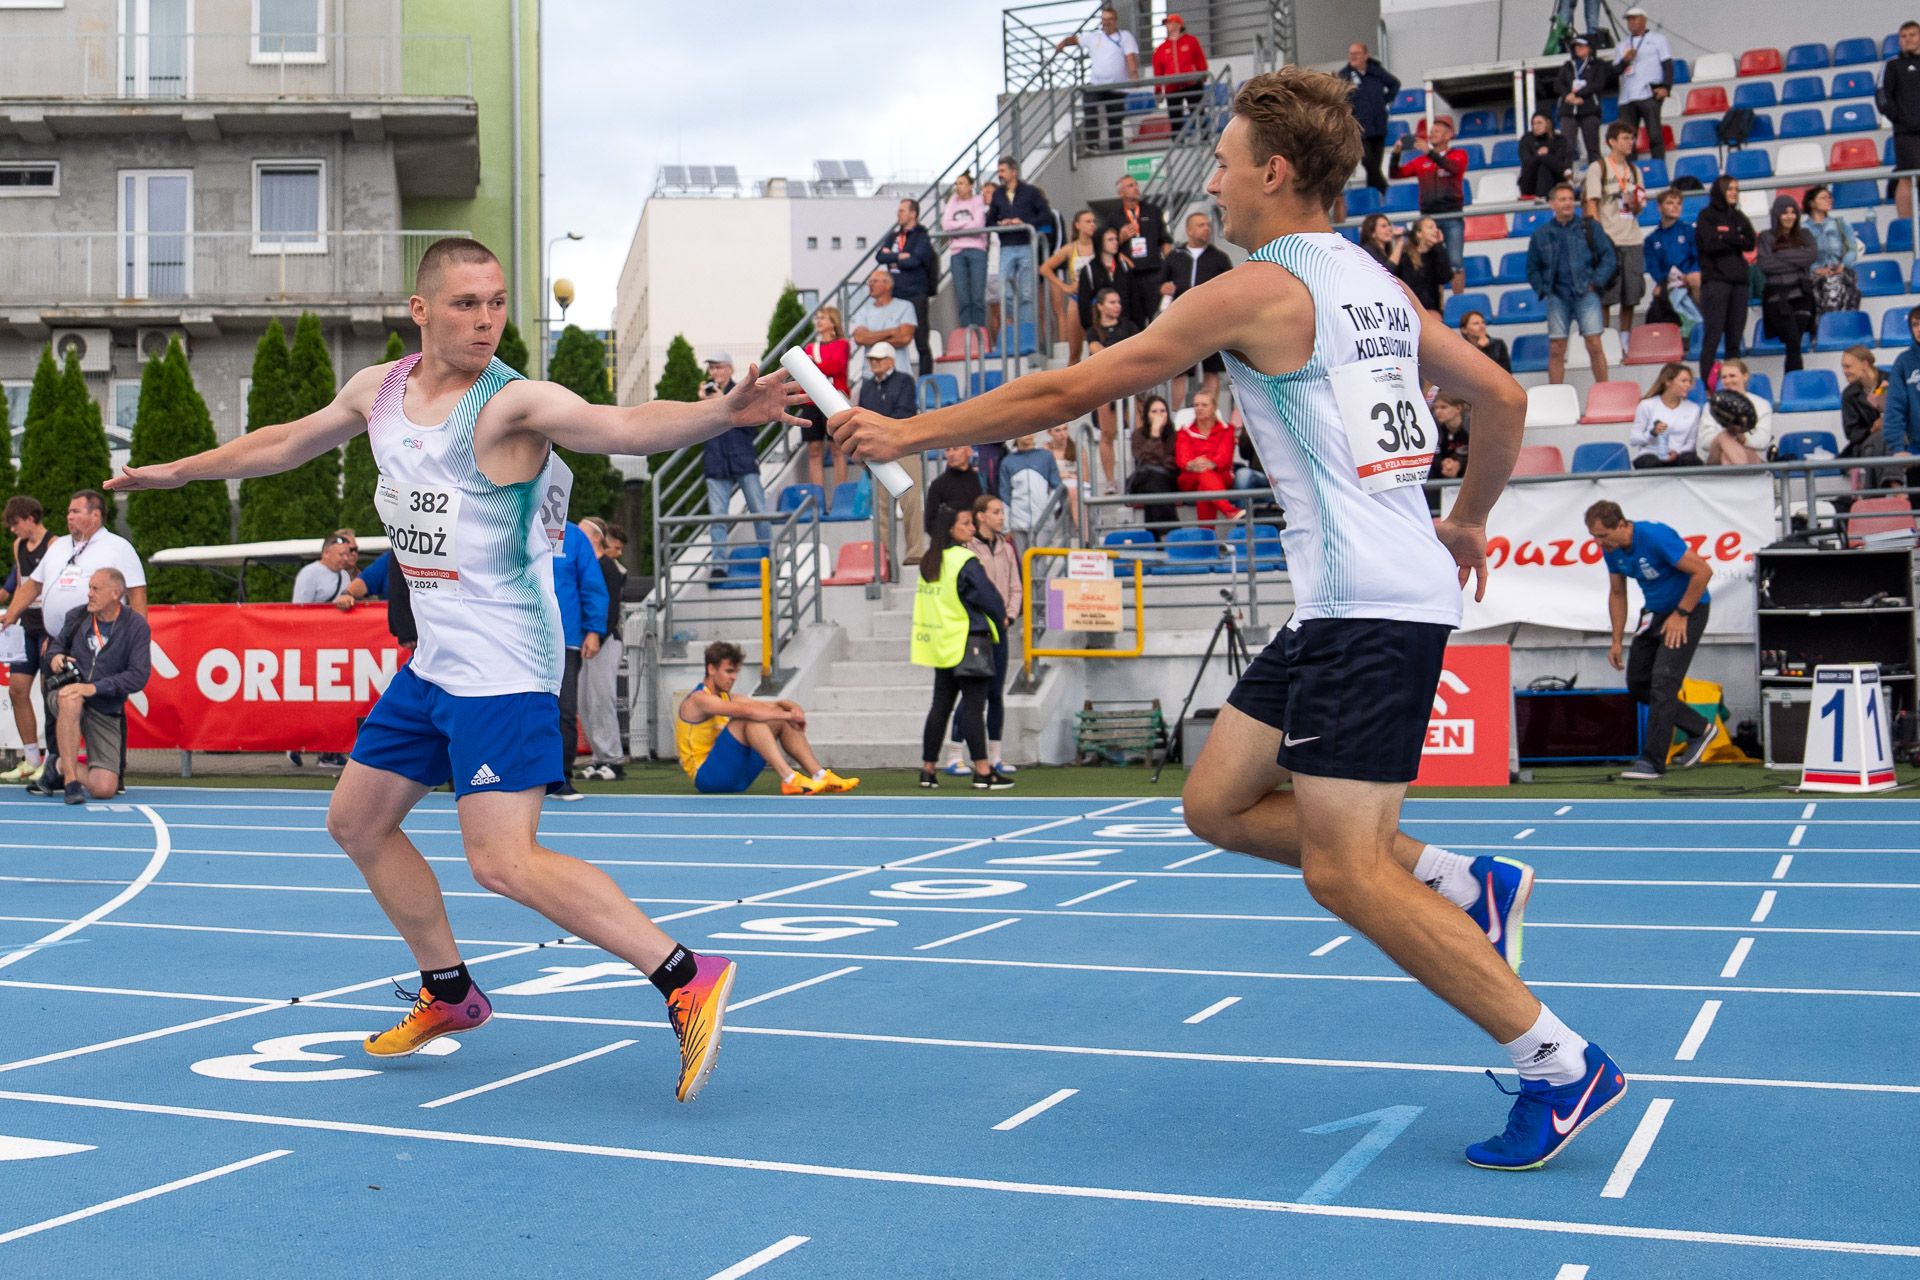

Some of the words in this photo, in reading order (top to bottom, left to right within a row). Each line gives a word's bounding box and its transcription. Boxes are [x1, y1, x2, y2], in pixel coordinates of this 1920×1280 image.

[1341, 302, 1411, 332] TIKI-TAKA
[1371, 400, 1426, 453] 383
[410, 491, 449, 514] 382
[414, 580, 438, 589] 2024
[196, 648, 398, 702] ORLEN
[1424, 726, 1465, 748] EN
[1821, 688, 1845, 762] 1
[1866, 688, 1884, 762] 1
[470, 775, 501, 786] adidas
[664, 948, 686, 973] PUMA
[432, 969, 460, 981] PUMA
